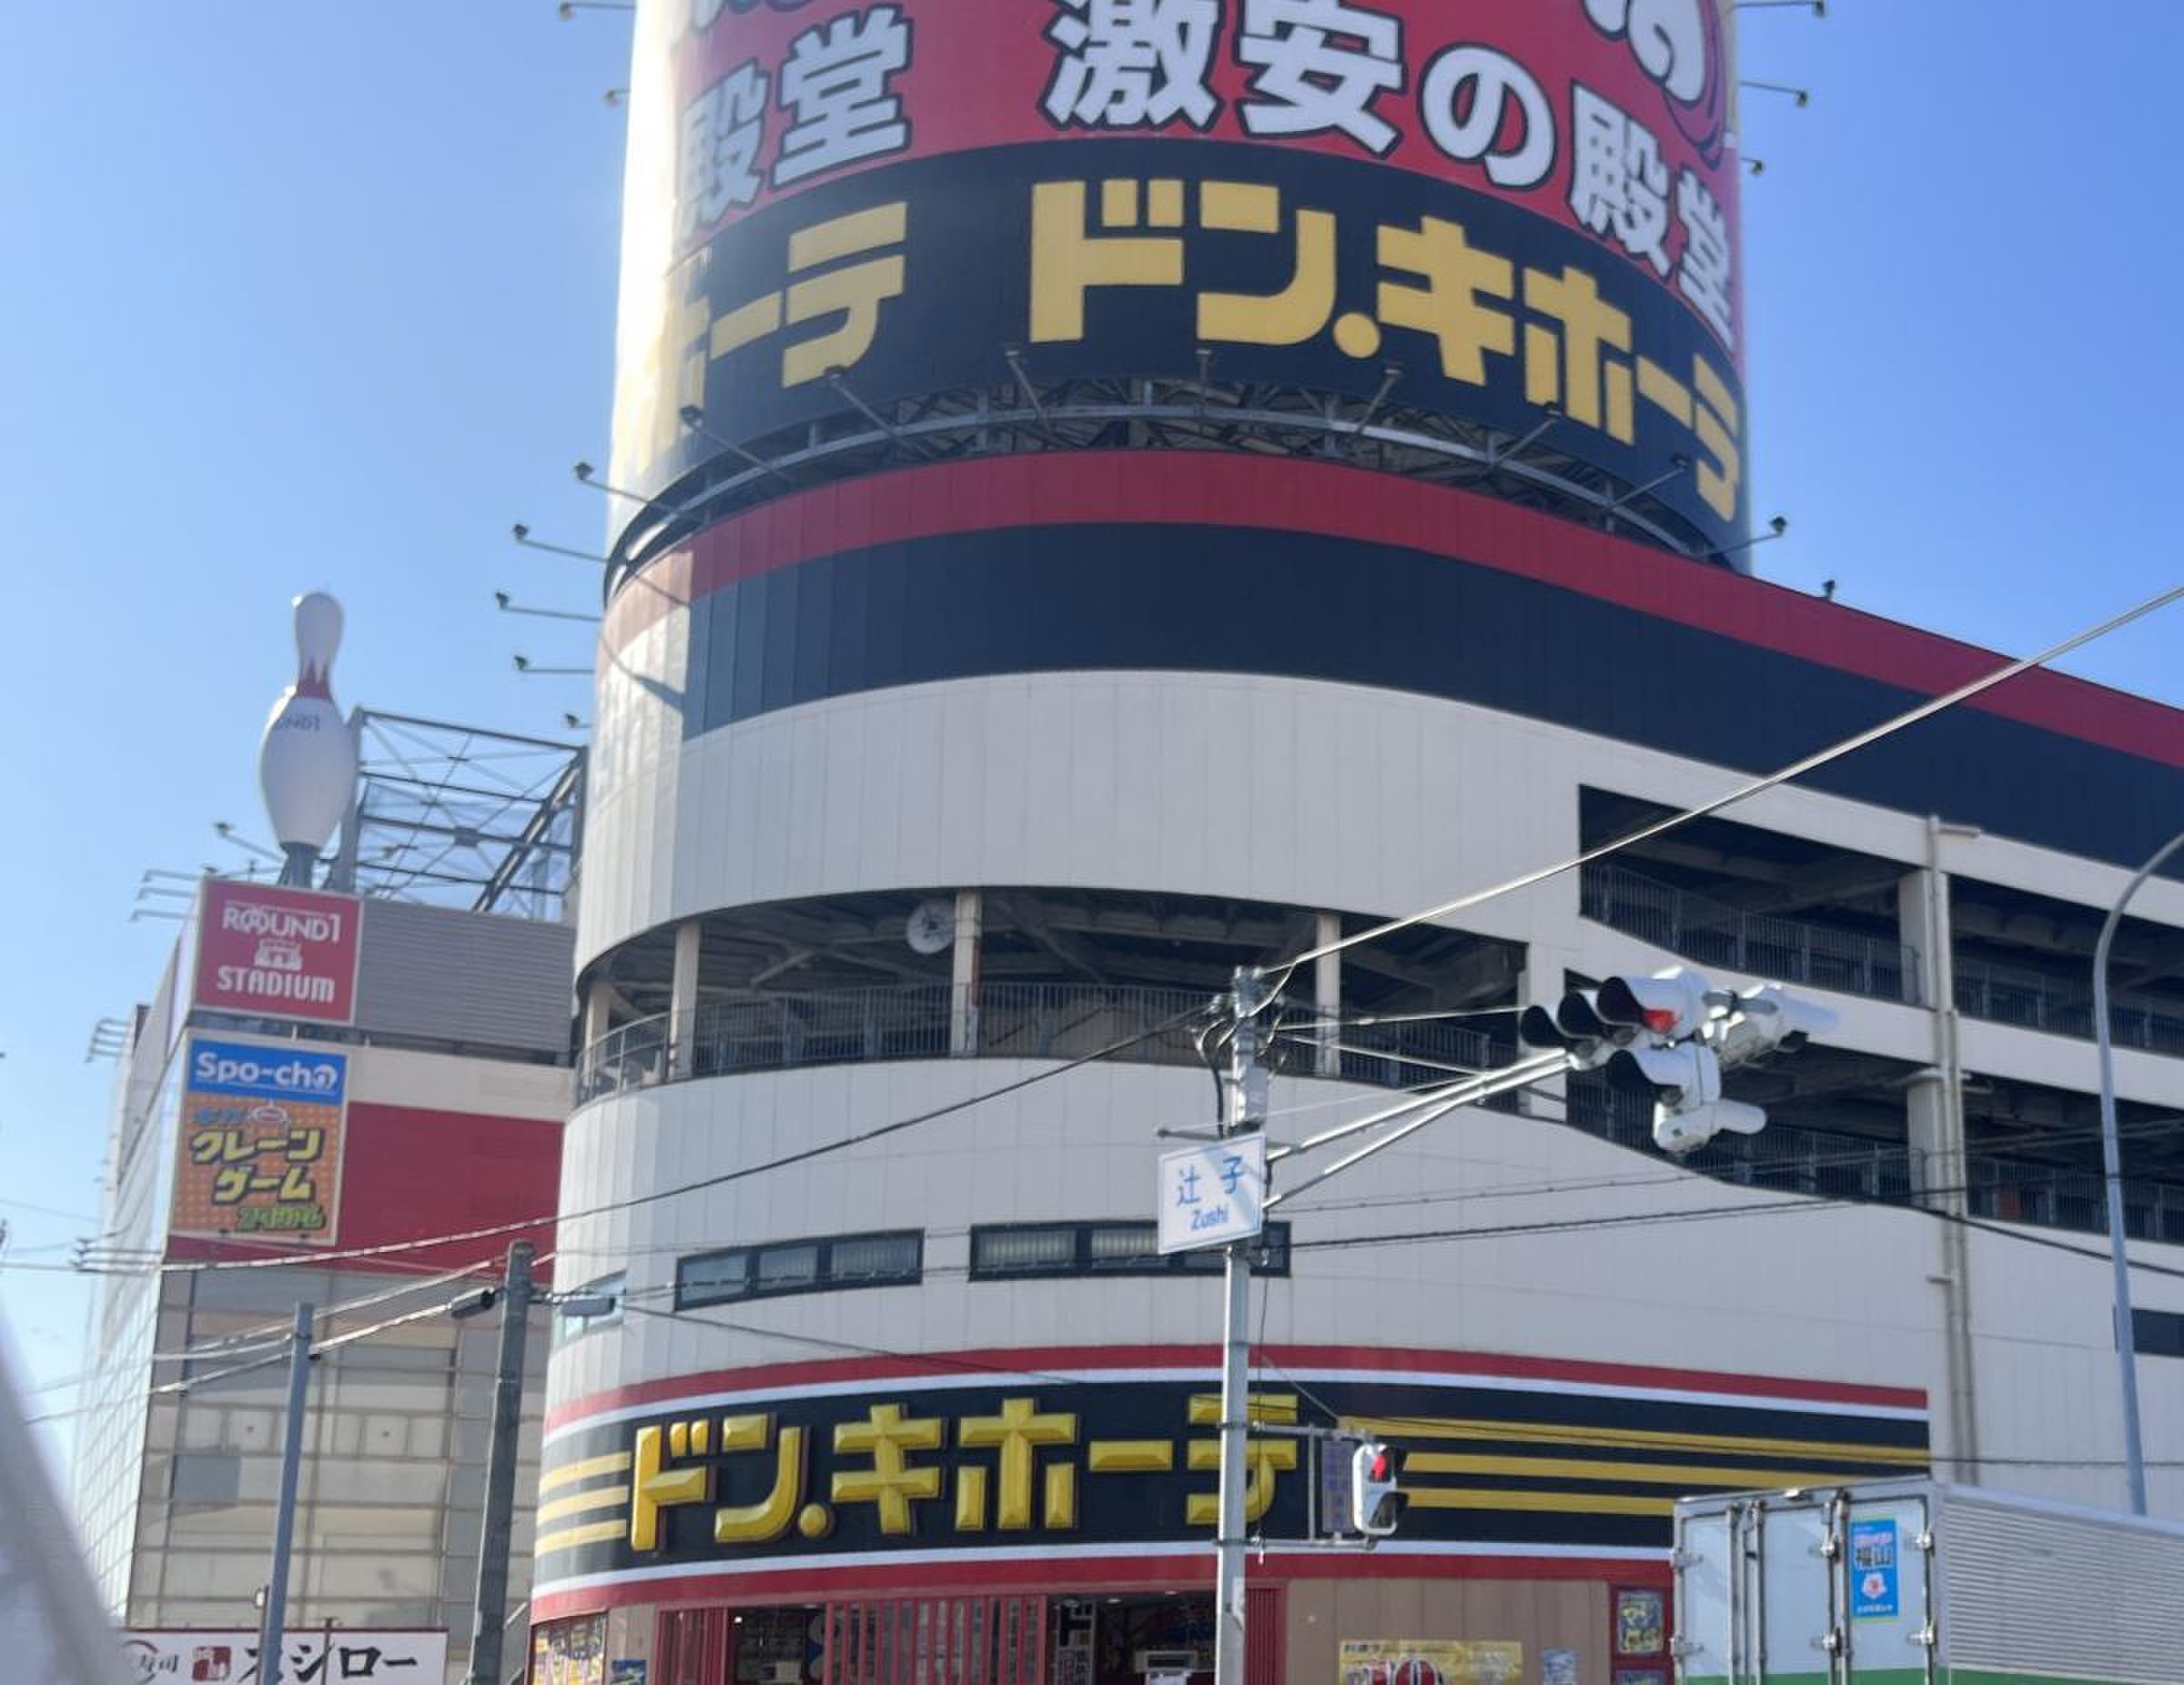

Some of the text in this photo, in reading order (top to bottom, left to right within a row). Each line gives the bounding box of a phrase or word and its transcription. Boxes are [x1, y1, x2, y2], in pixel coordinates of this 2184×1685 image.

[222, 905, 341, 943] ROUND1
[217, 965, 335, 1004] STADIUM
[191, 1129, 321, 1163] クレーン
[214, 1165, 312, 1203] ゲーム
[1178, 1155, 1244, 1206] 辻子
[1192, 1206, 1228, 1230] Zushi
